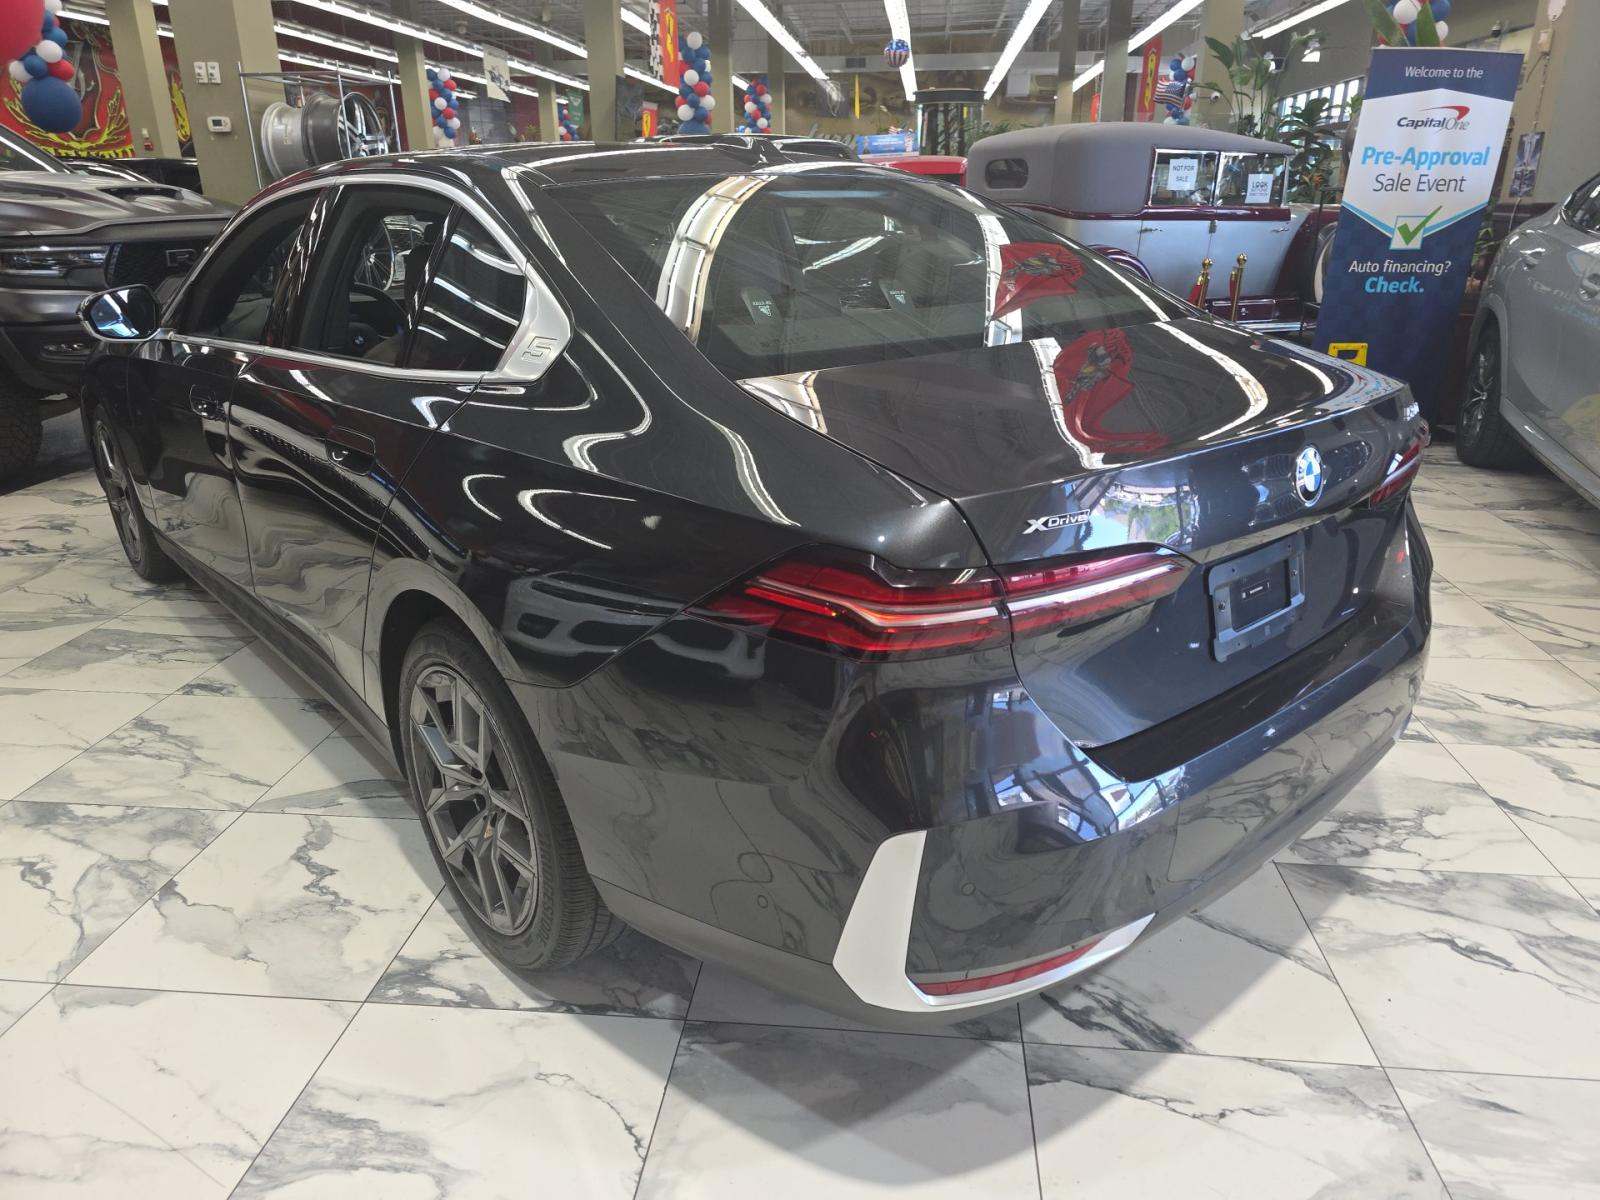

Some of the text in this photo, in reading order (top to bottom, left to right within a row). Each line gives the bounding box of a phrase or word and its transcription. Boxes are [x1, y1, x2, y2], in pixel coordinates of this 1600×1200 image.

[1405, 66, 1484, 78] Welcome to the
[1361, 146, 1491, 170] Pre-Approval
[1373, 172, 1467, 192] Sale Event
[1348, 259, 1452, 276] Auto financing?
[1364, 276, 1425, 293] Check.
